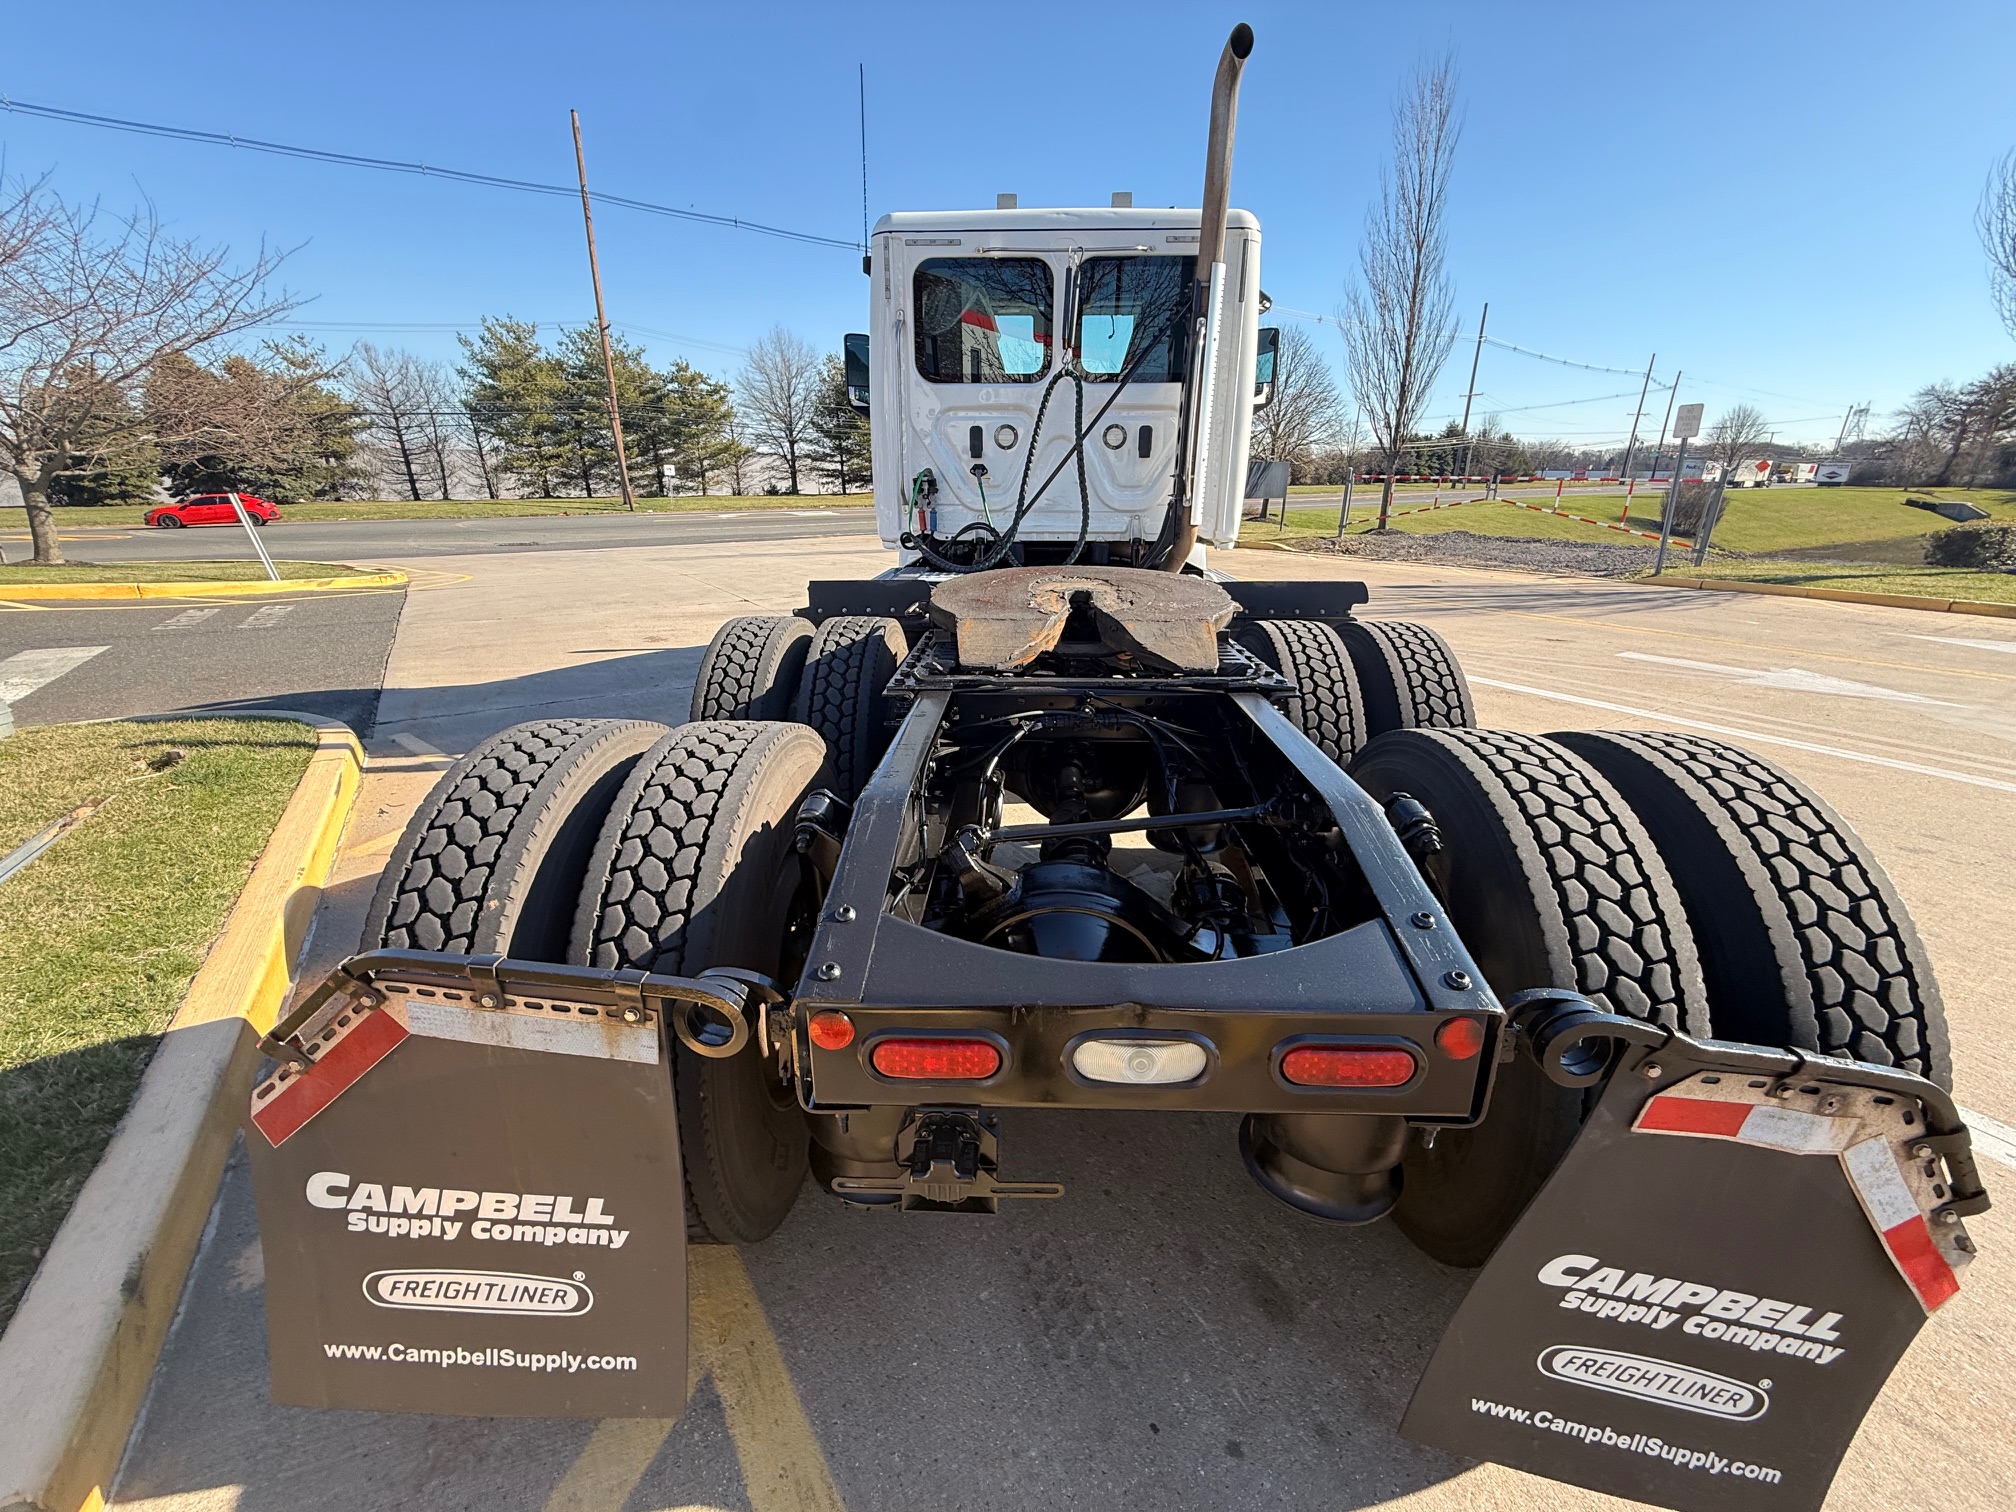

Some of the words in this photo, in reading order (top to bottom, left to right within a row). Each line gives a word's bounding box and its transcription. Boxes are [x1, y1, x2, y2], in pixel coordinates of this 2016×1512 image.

[306, 1172, 615, 1225] CAMPBELL
[347, 1212, 463, 1240] Supply
[471, 1220, 630, 1248] Company
[389, 1280, 568, 1305] FREIGHTLINER
[1538, 1255, 1844, 1341] CAMPBELL
[1559, 1290, 1682, 1330] Supply
[1682, 1315, 1845, 1364] Company
[323, 1343, 638, 1373] www.CampbellSupply.com
[1560, 1356, 1744, 1409] FREIGHTLINER
[1471, 1398, 1782, 1484] www.CampbellSupply.com
